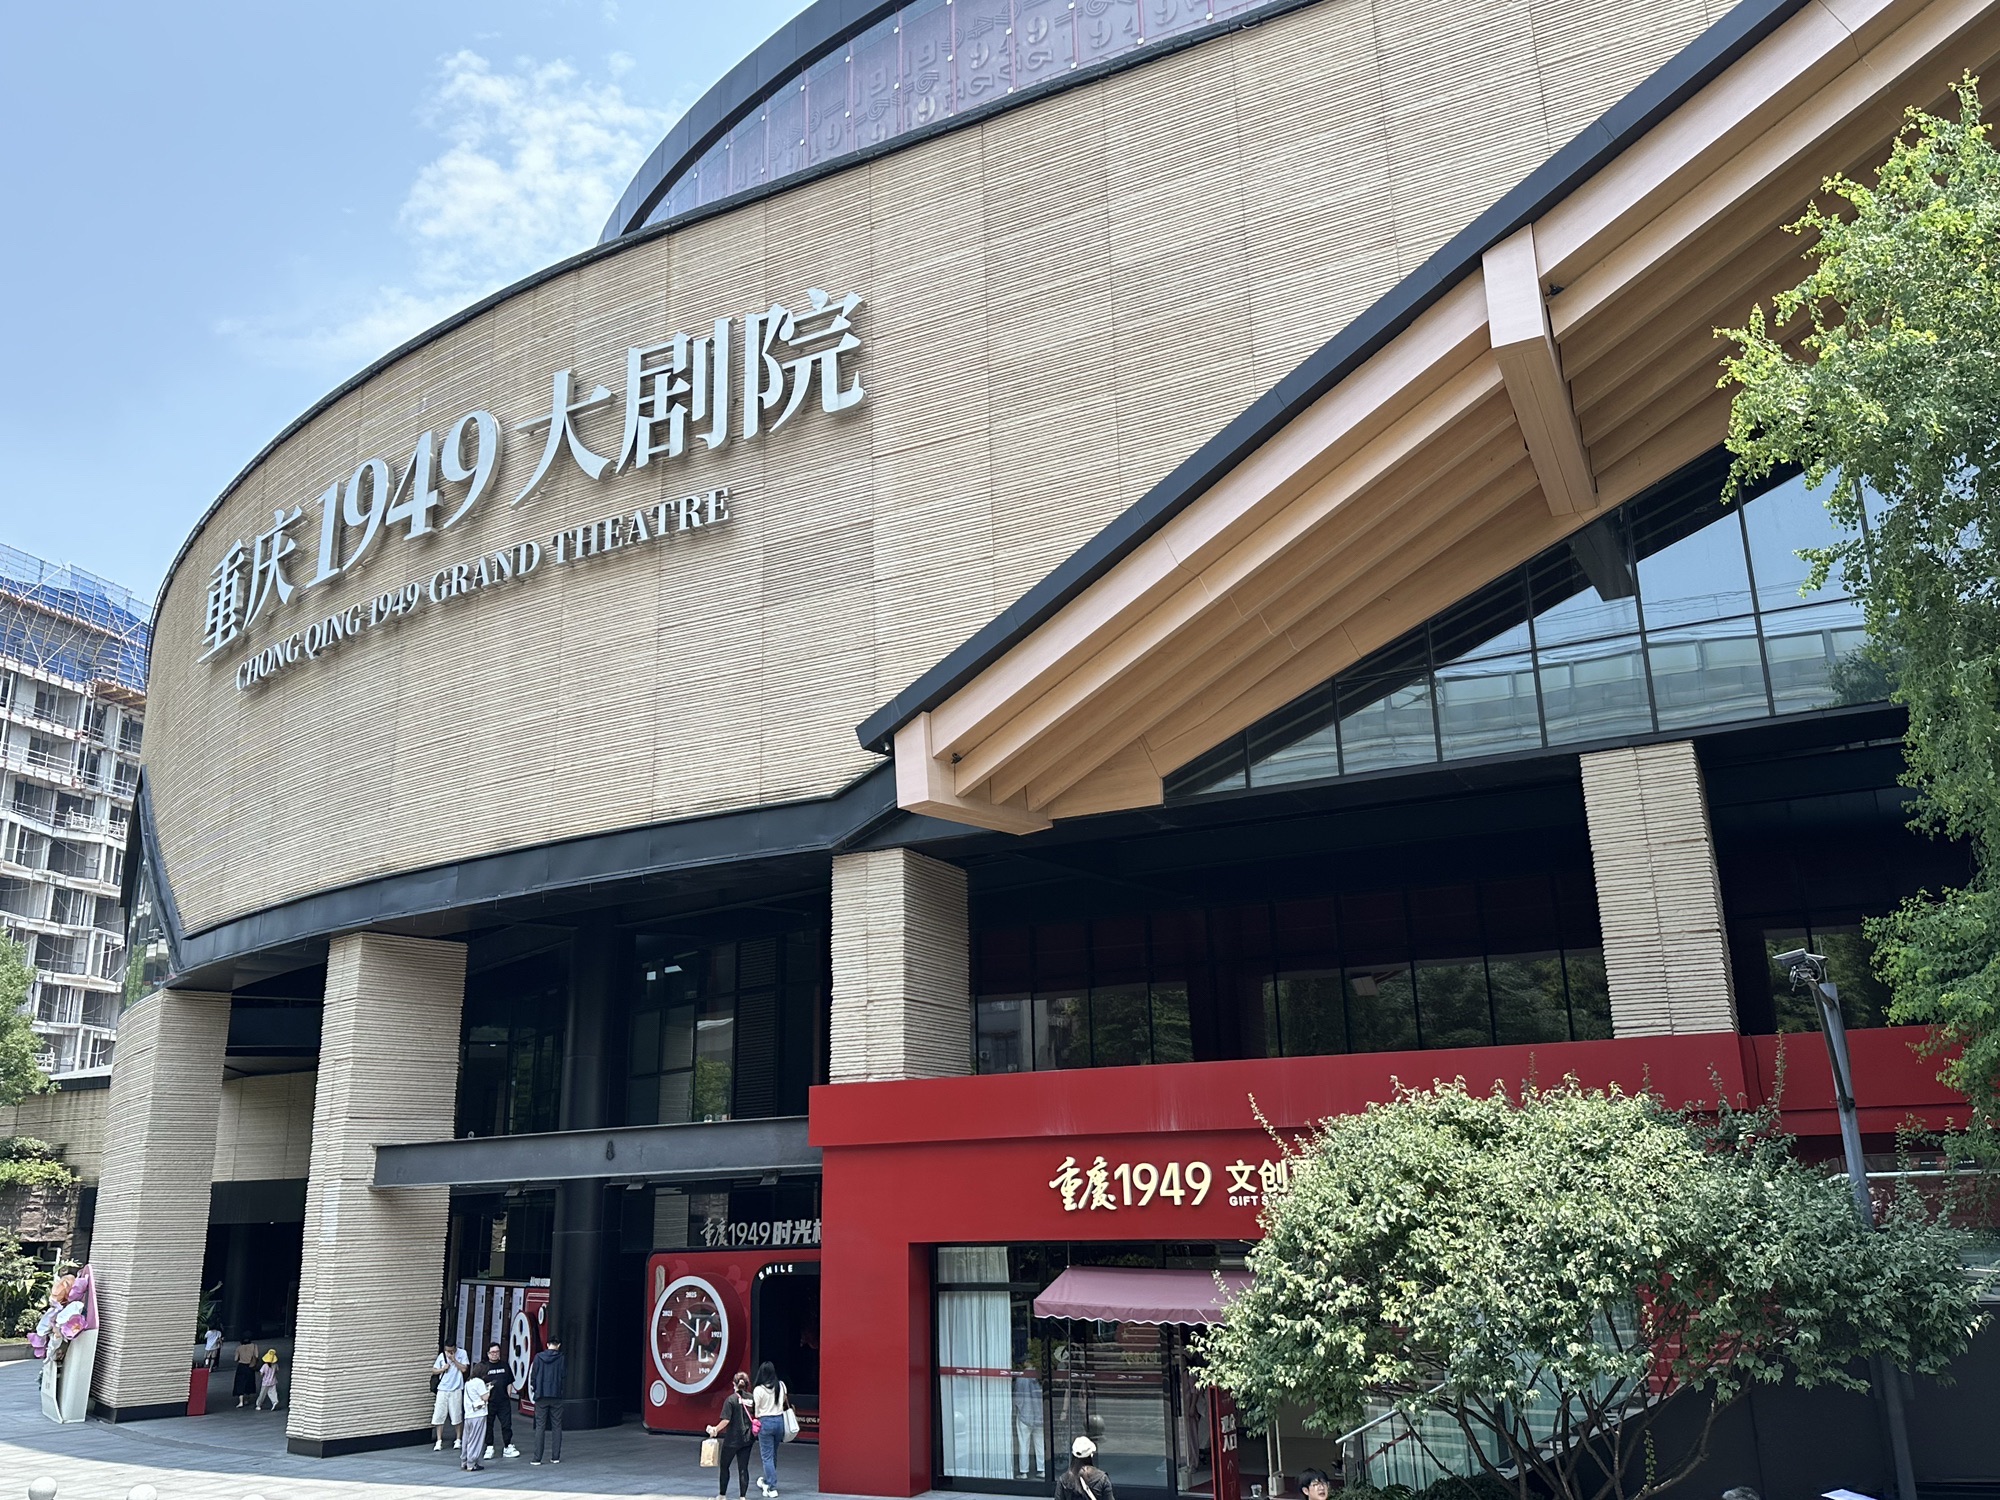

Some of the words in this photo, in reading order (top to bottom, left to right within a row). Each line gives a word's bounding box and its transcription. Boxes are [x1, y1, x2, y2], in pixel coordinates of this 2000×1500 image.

[236, 633, 301, 691] CHONG
[304, 604, 363, 660] QING
[368, 582, 425, 627] 1949
[429, 541, 546, 603] GRAND
[552, 487, 732, 565] THEATRE
[1225, 1159, 1313, 1194] 文创
[1229, 1195, 1259, 1207] GIFT
[758, 1264, 793, 1280] SMILE
[1222, 1433, 1238, 1453] 入口
